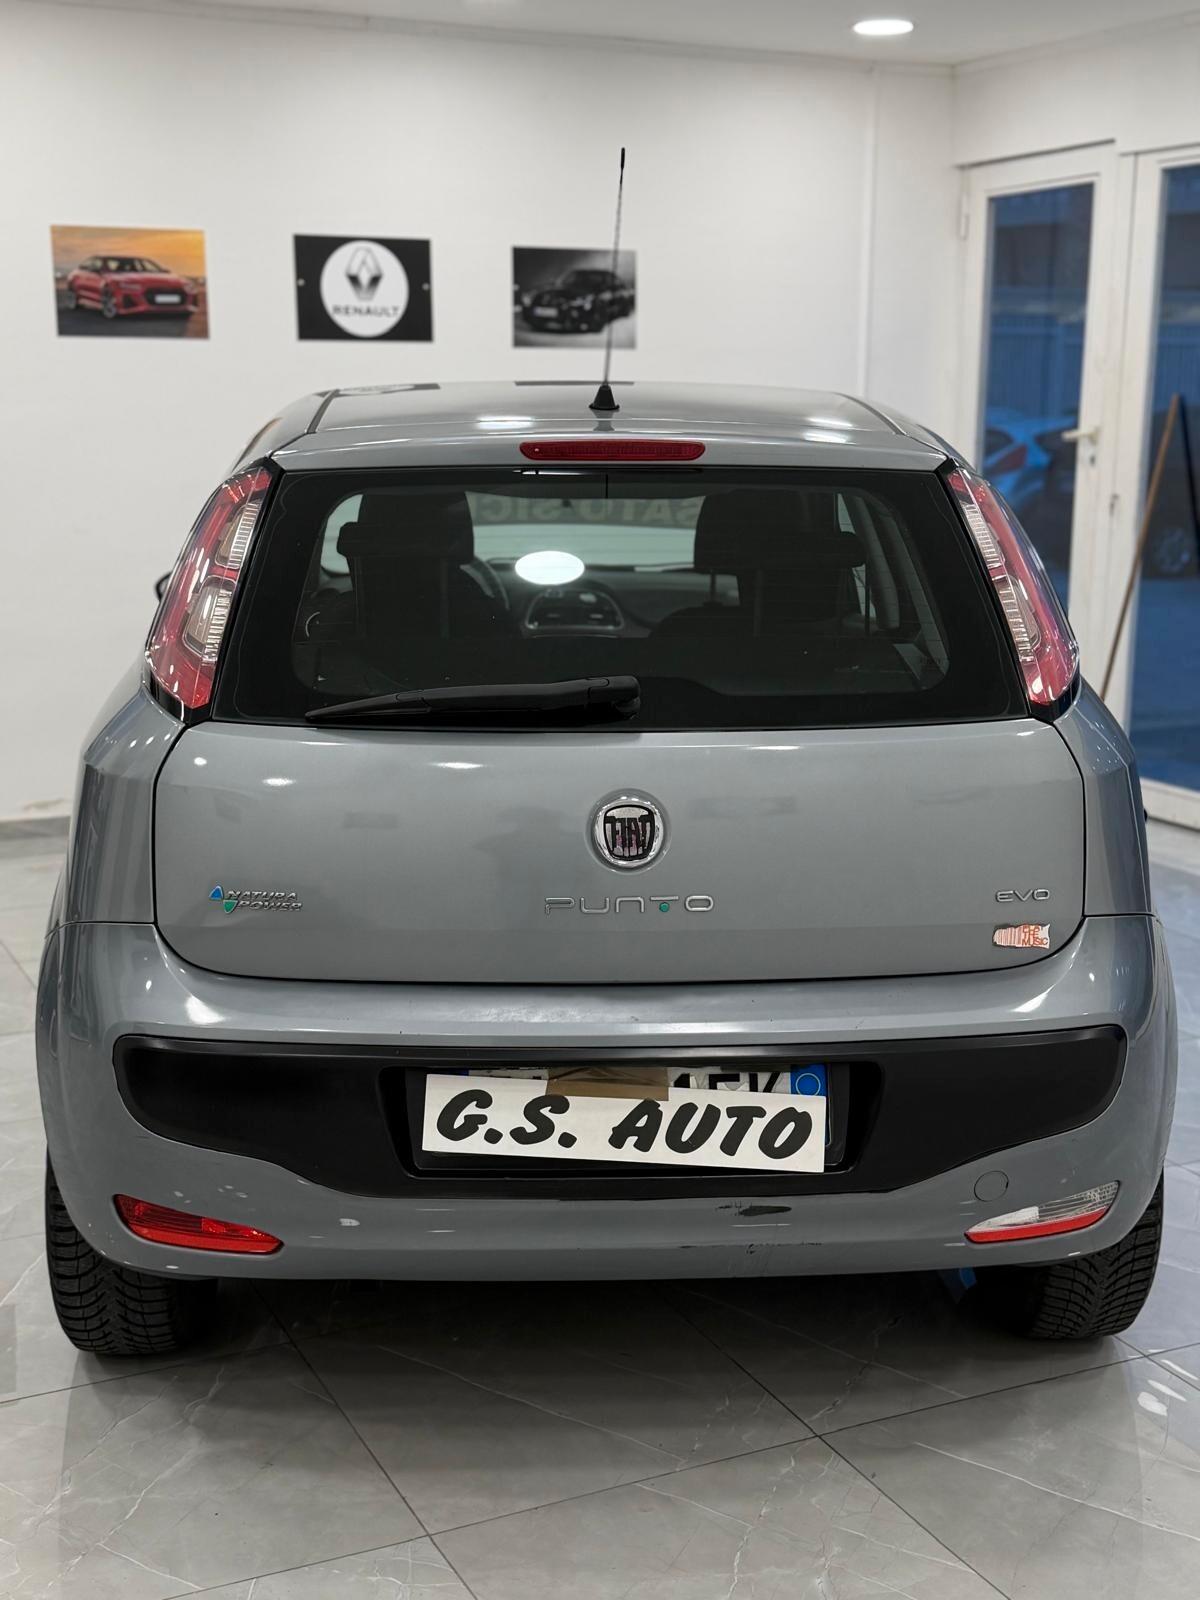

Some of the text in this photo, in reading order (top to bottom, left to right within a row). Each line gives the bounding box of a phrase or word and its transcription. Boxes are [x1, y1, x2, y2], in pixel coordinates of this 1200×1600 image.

[332, 305, 399, 318] RENAULT
[604, 815, 653, 856] FIAT
[996, 888, 1050, 902] EVO
[238, 900, 303, 911] POWER
[544, 895, 714, 916] PUNTO
[436, 1089, 813, 1160] G.S. AUTO
